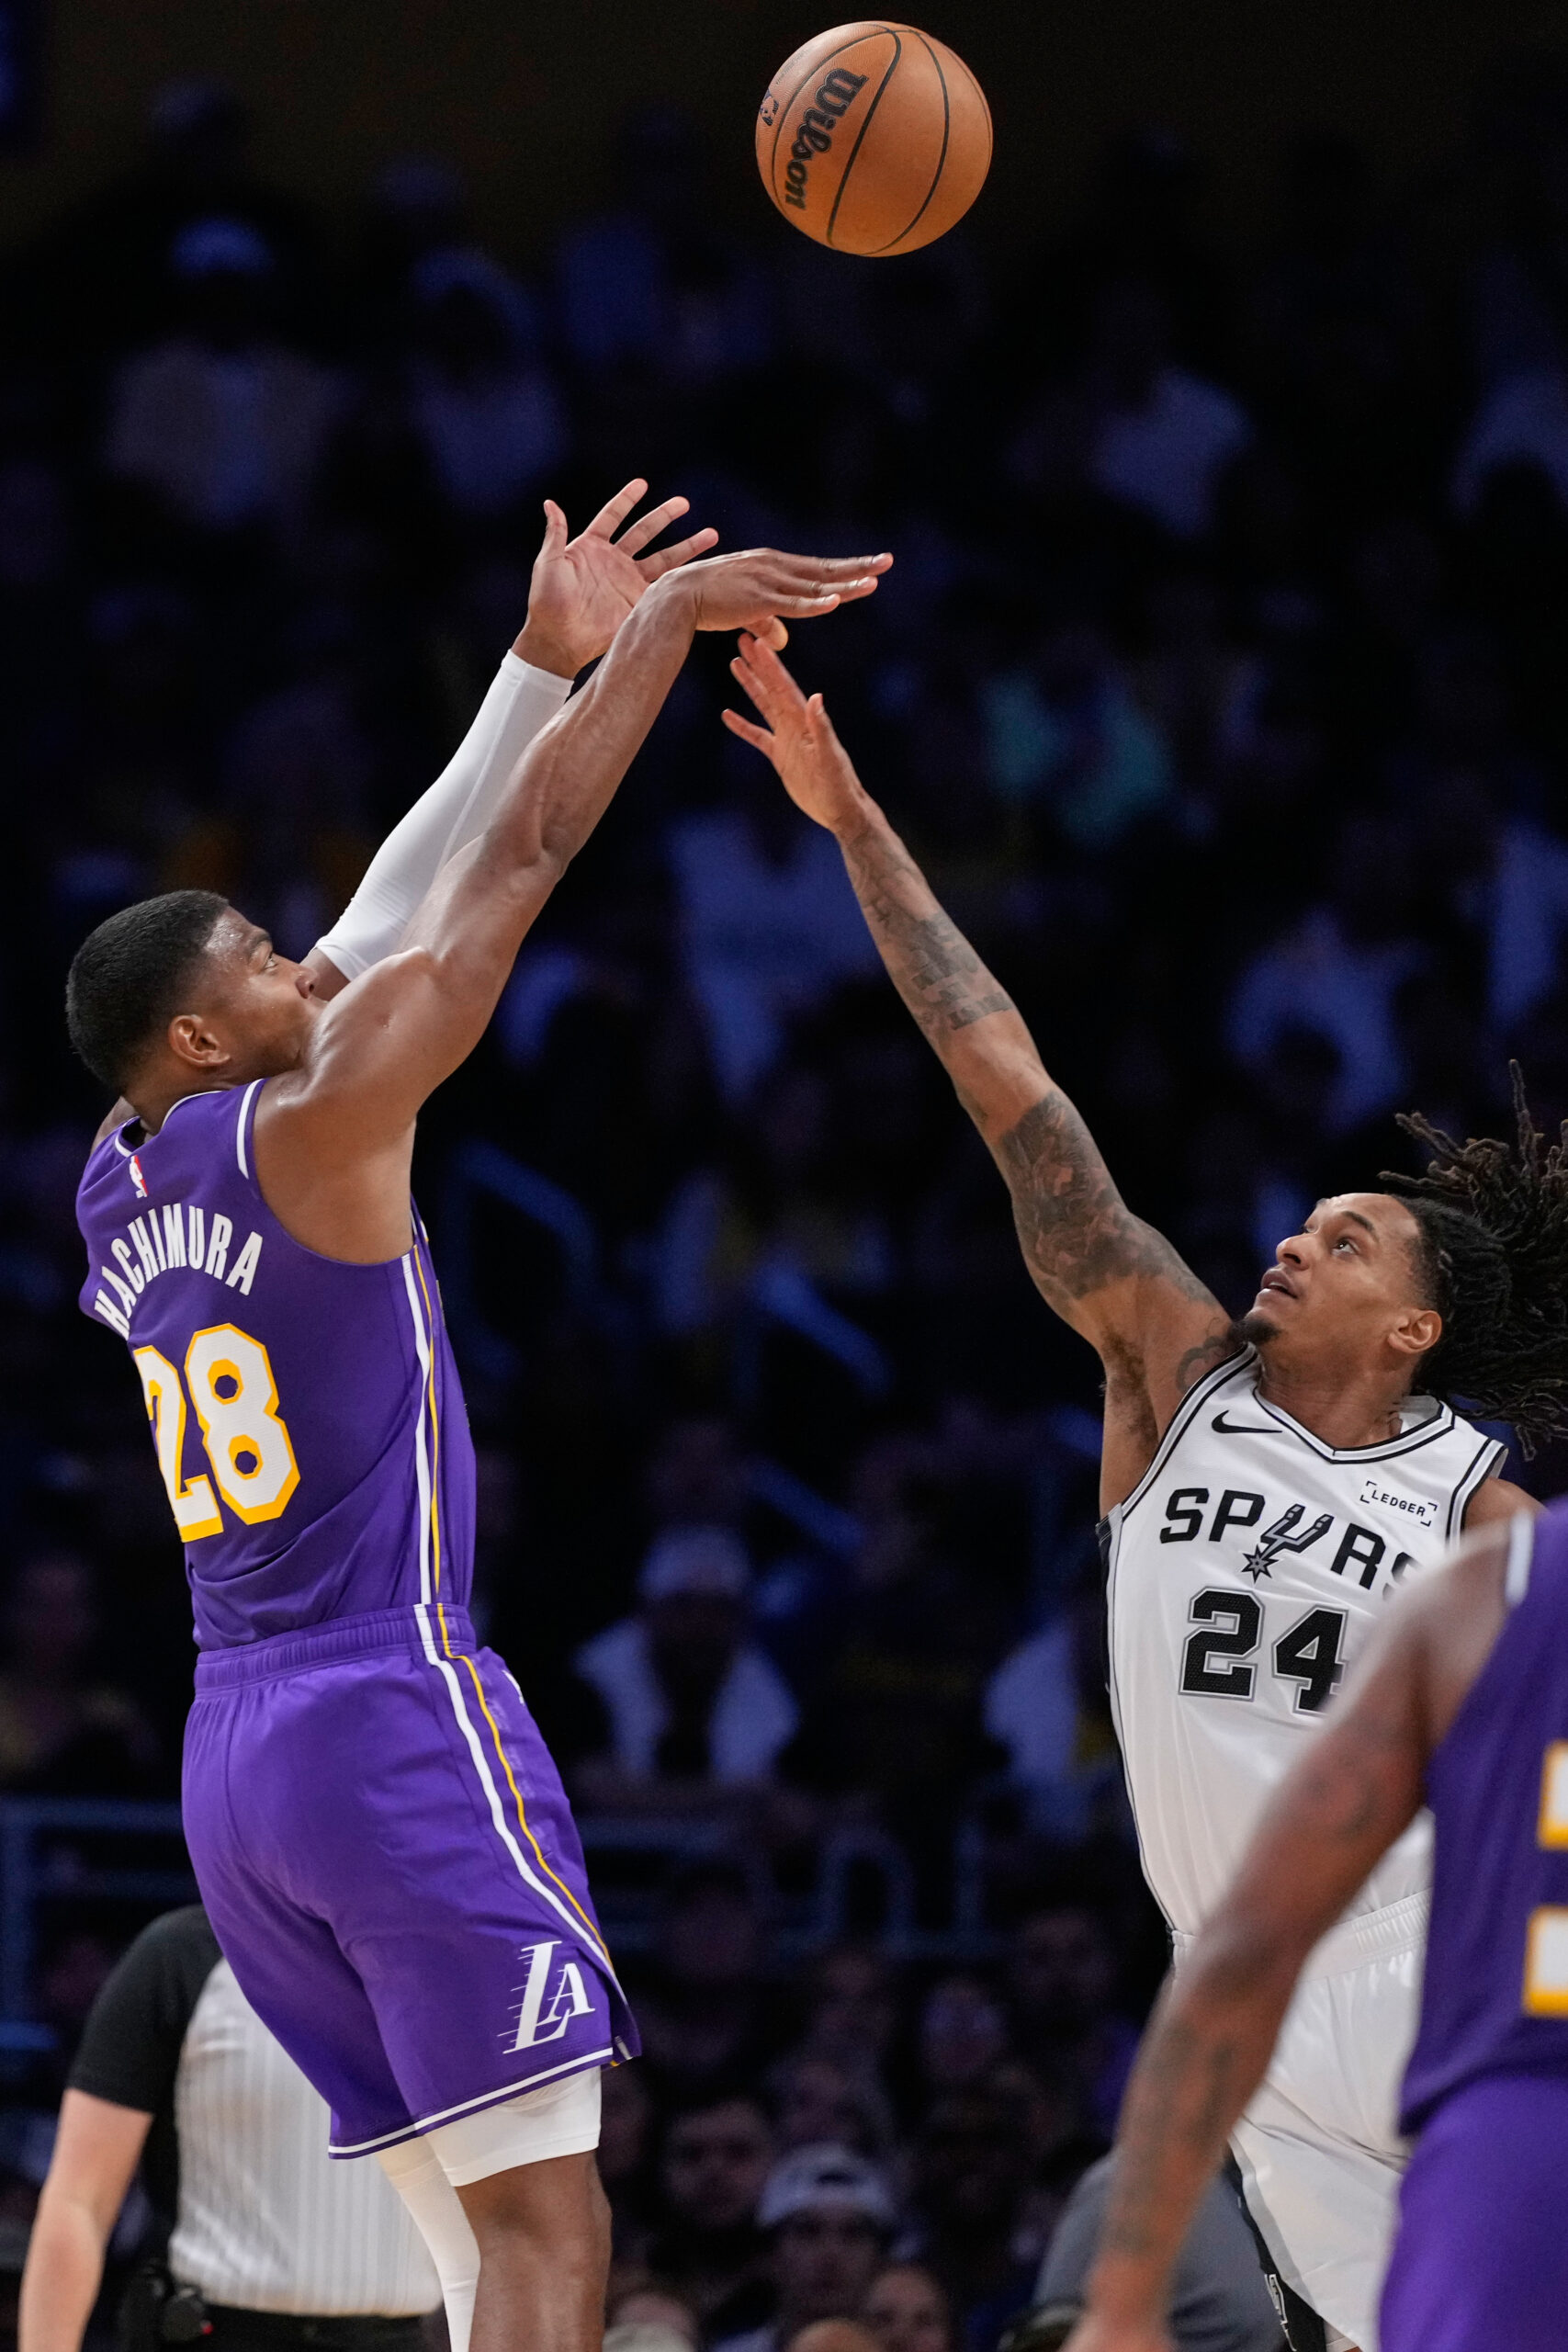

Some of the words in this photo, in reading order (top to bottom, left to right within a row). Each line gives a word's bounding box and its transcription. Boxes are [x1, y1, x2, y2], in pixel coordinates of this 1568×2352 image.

[784, 68, 869, 209] Wilson
[94, 1203, 264, 1341] HACHIMURA
[132, 1322, 301, 1544] 28
[1371, 1489, 1427, 1517] LEDGER
[1178, 1586, 1349, 1718] 24
[497, 1940, 596, 2054] LA
